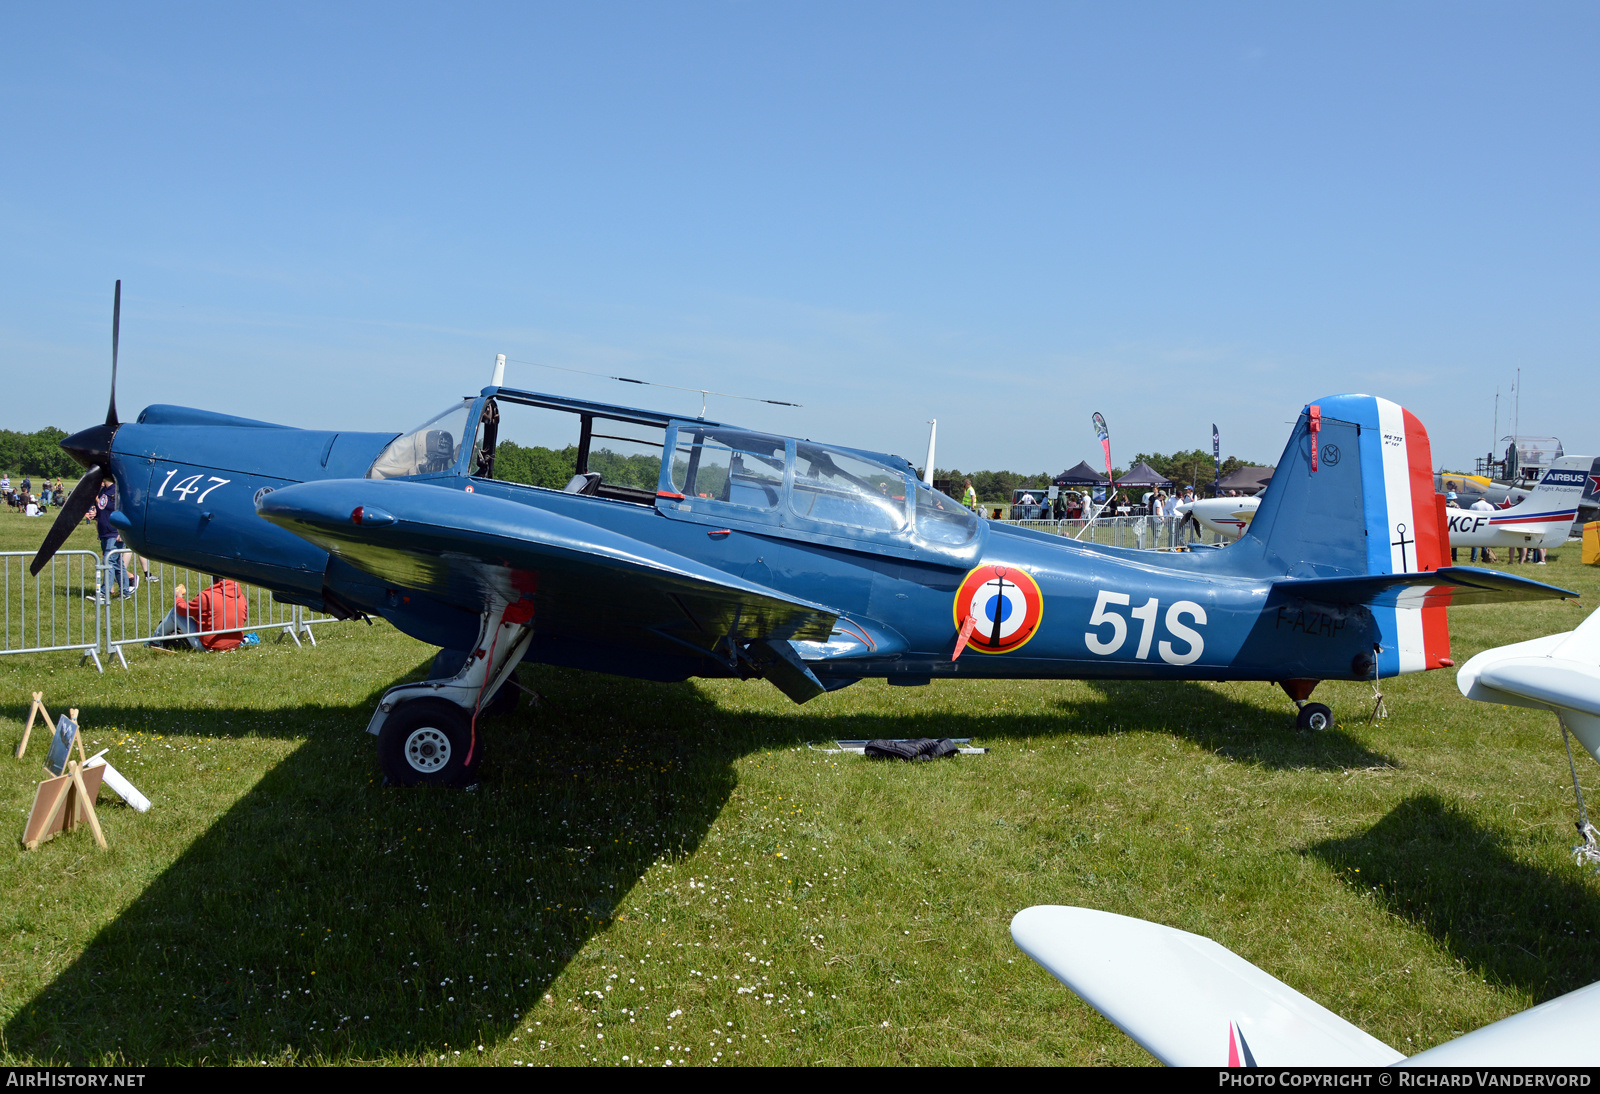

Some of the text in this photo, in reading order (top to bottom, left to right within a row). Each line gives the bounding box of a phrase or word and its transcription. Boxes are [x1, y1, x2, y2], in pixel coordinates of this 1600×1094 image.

[157, 469, 231, 504] 147
[1538, 485, 1582, 494] Flight Academy
[1546, 473, 1584, 482] AIRBUS
[1447, 516, 1488, 533] KCF
[1084, 589, 1208, 666] 51S
[1276, 606, 1347, 638] F-AZRP
